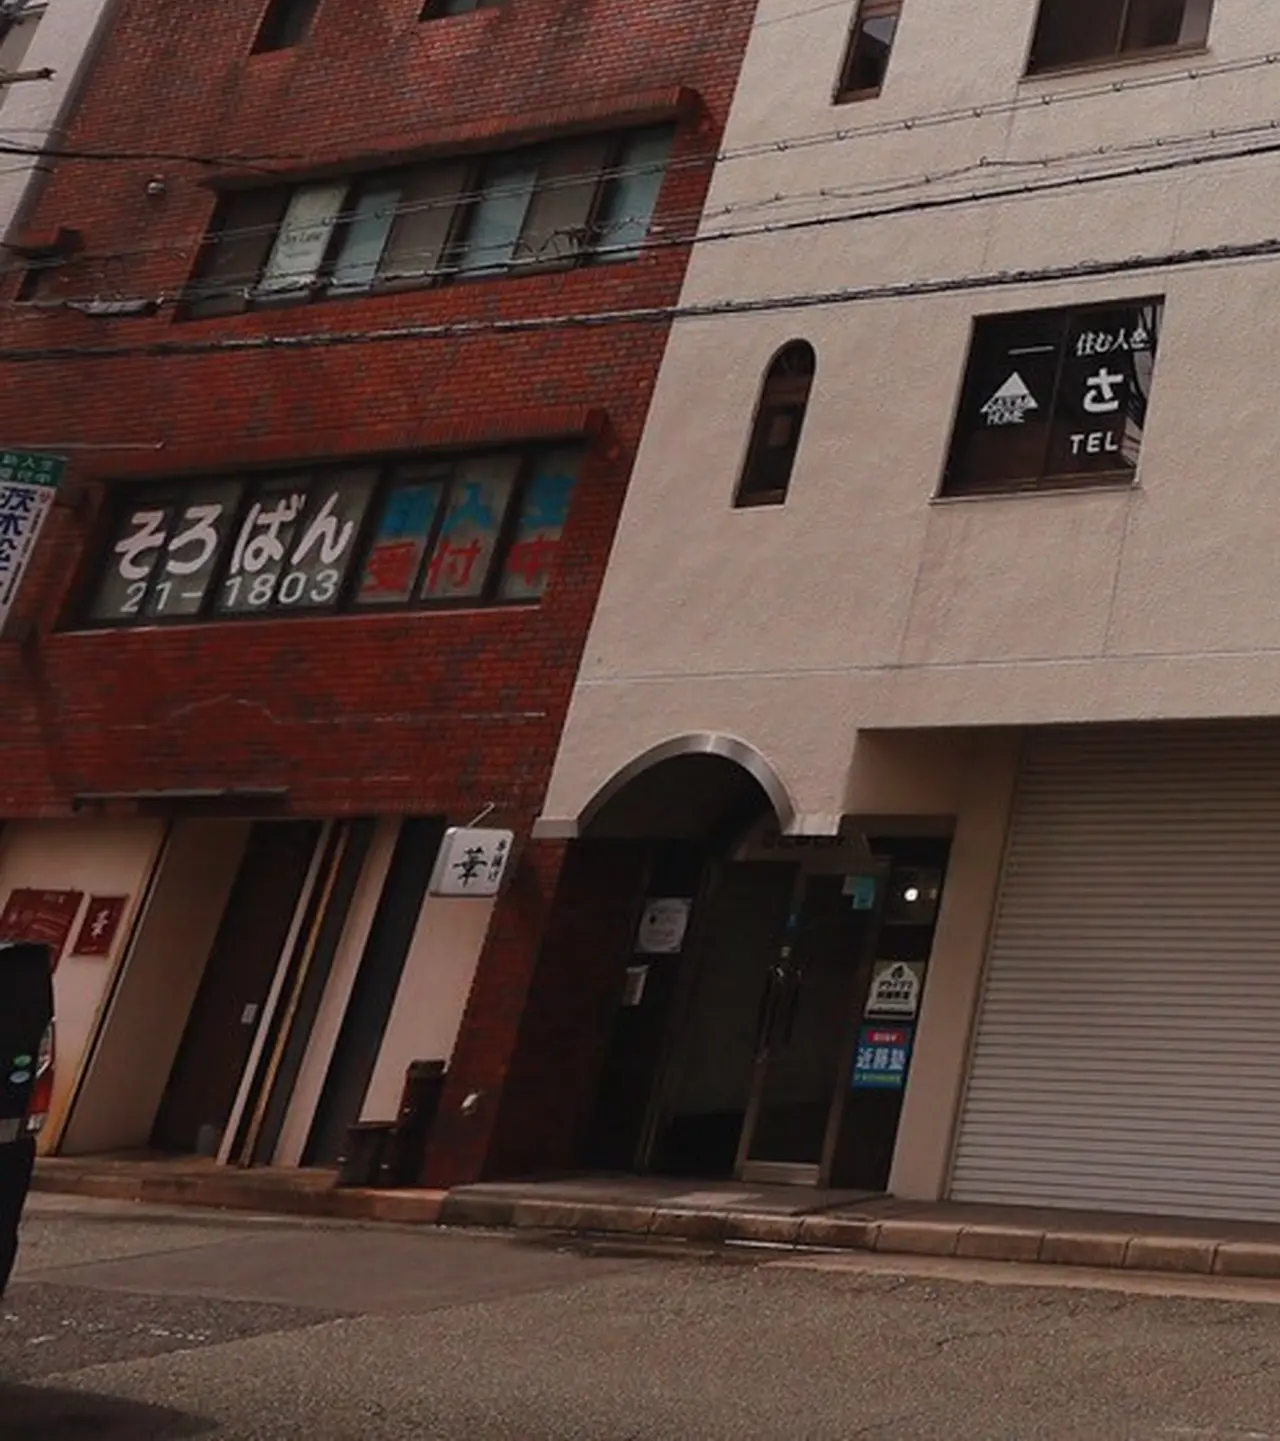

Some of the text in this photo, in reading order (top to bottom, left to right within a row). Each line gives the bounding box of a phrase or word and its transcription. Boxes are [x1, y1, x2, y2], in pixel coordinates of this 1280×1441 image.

[1069, 432, 1119, 455] TEL
[115, 492, 353, 580] そろばん
[120, 568, 340, 614] 21-1803
